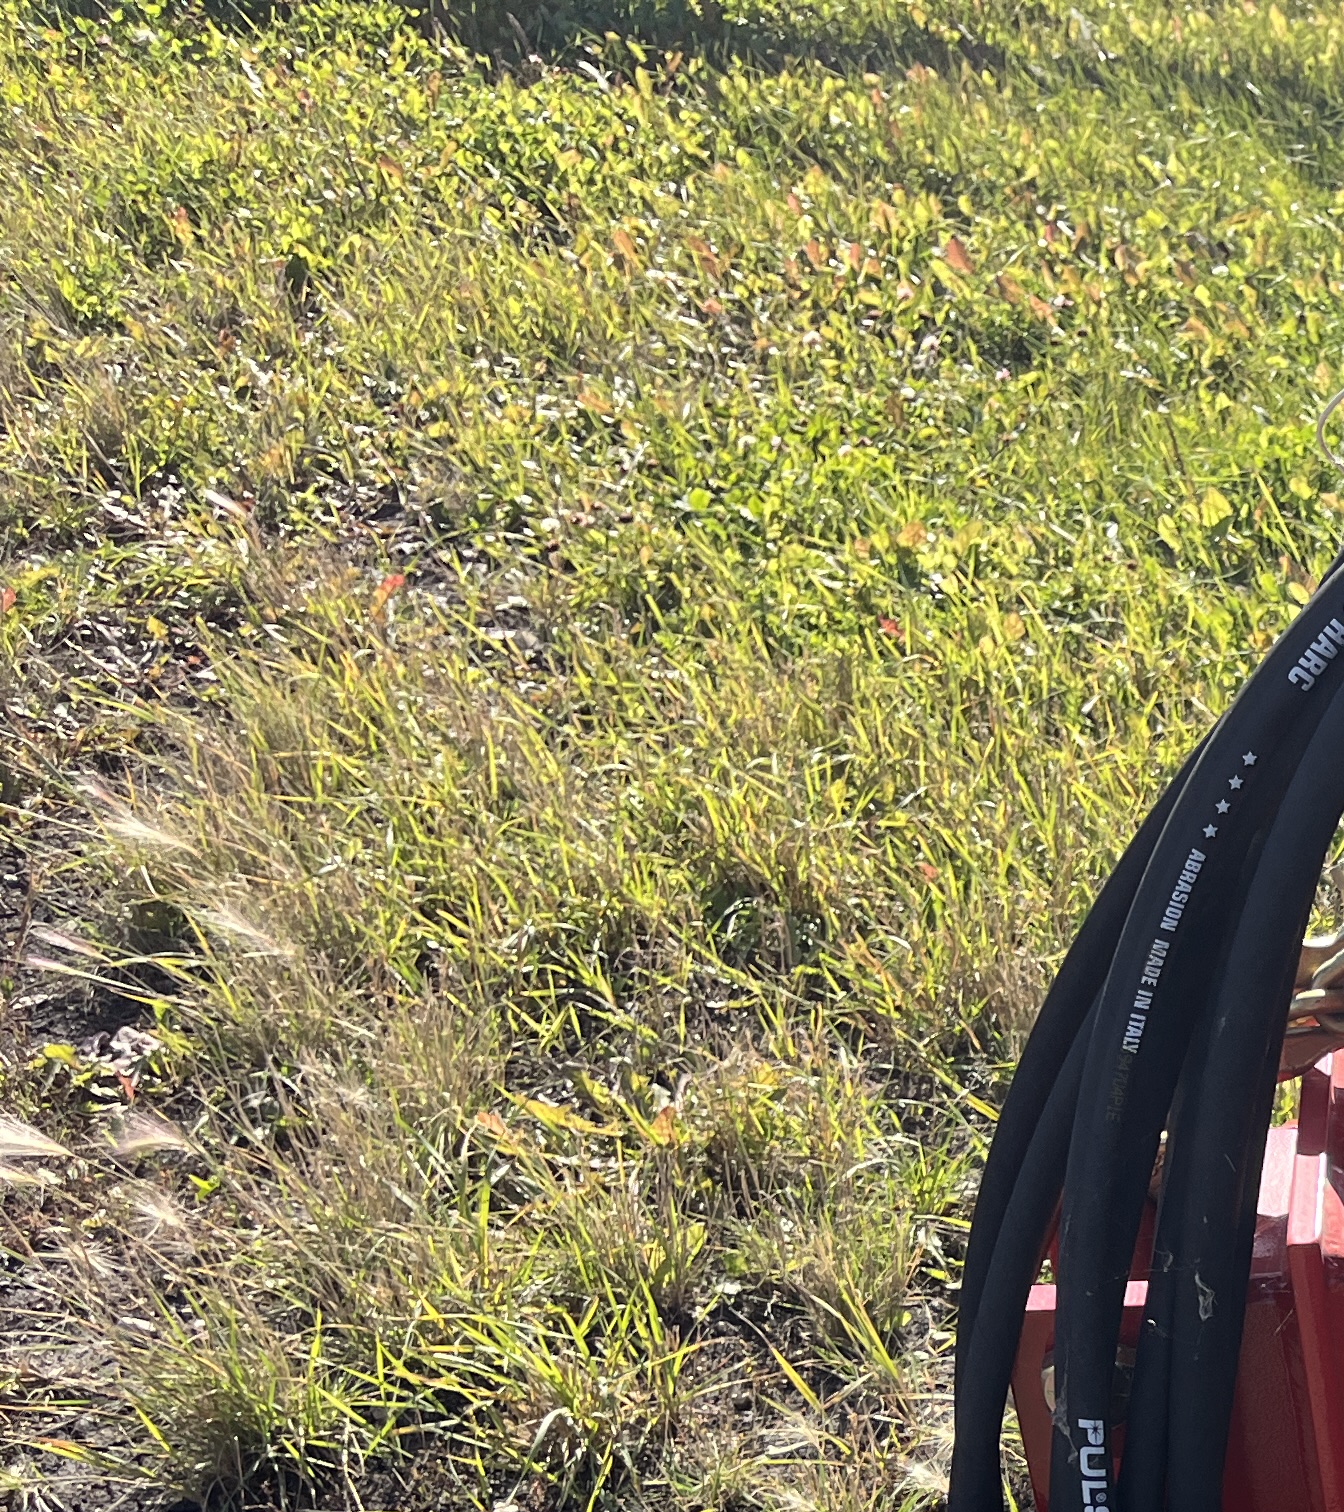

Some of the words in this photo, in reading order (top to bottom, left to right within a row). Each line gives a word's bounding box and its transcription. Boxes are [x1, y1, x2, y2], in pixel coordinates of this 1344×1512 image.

[1160, 848, 1207, 932] ABRASION
[1140, 938, 1170, 987] MADE
[1133, 989, 1154, 1010] IN
[1122, 1013, 1147, 1054] ITALY
